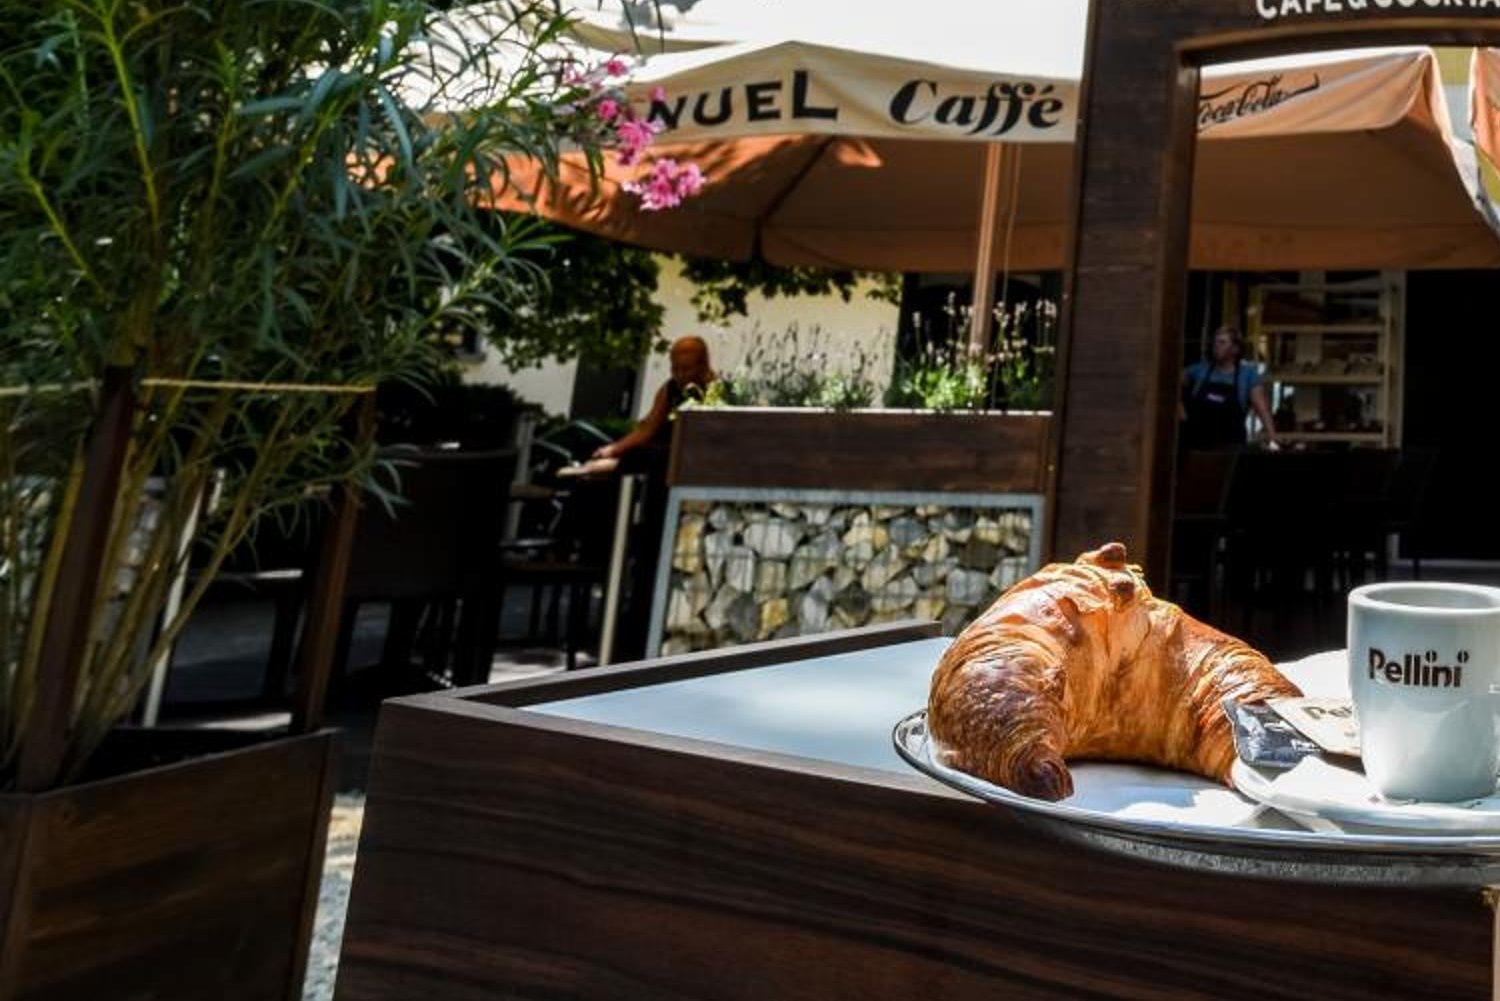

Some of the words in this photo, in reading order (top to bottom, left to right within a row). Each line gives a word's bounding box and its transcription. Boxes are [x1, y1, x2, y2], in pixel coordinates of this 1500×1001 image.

[648, 69, 839, 131] NUEL
[888, 78, 1064, 136] Caffé
[1368, 646, 1471, 689] Pellini
